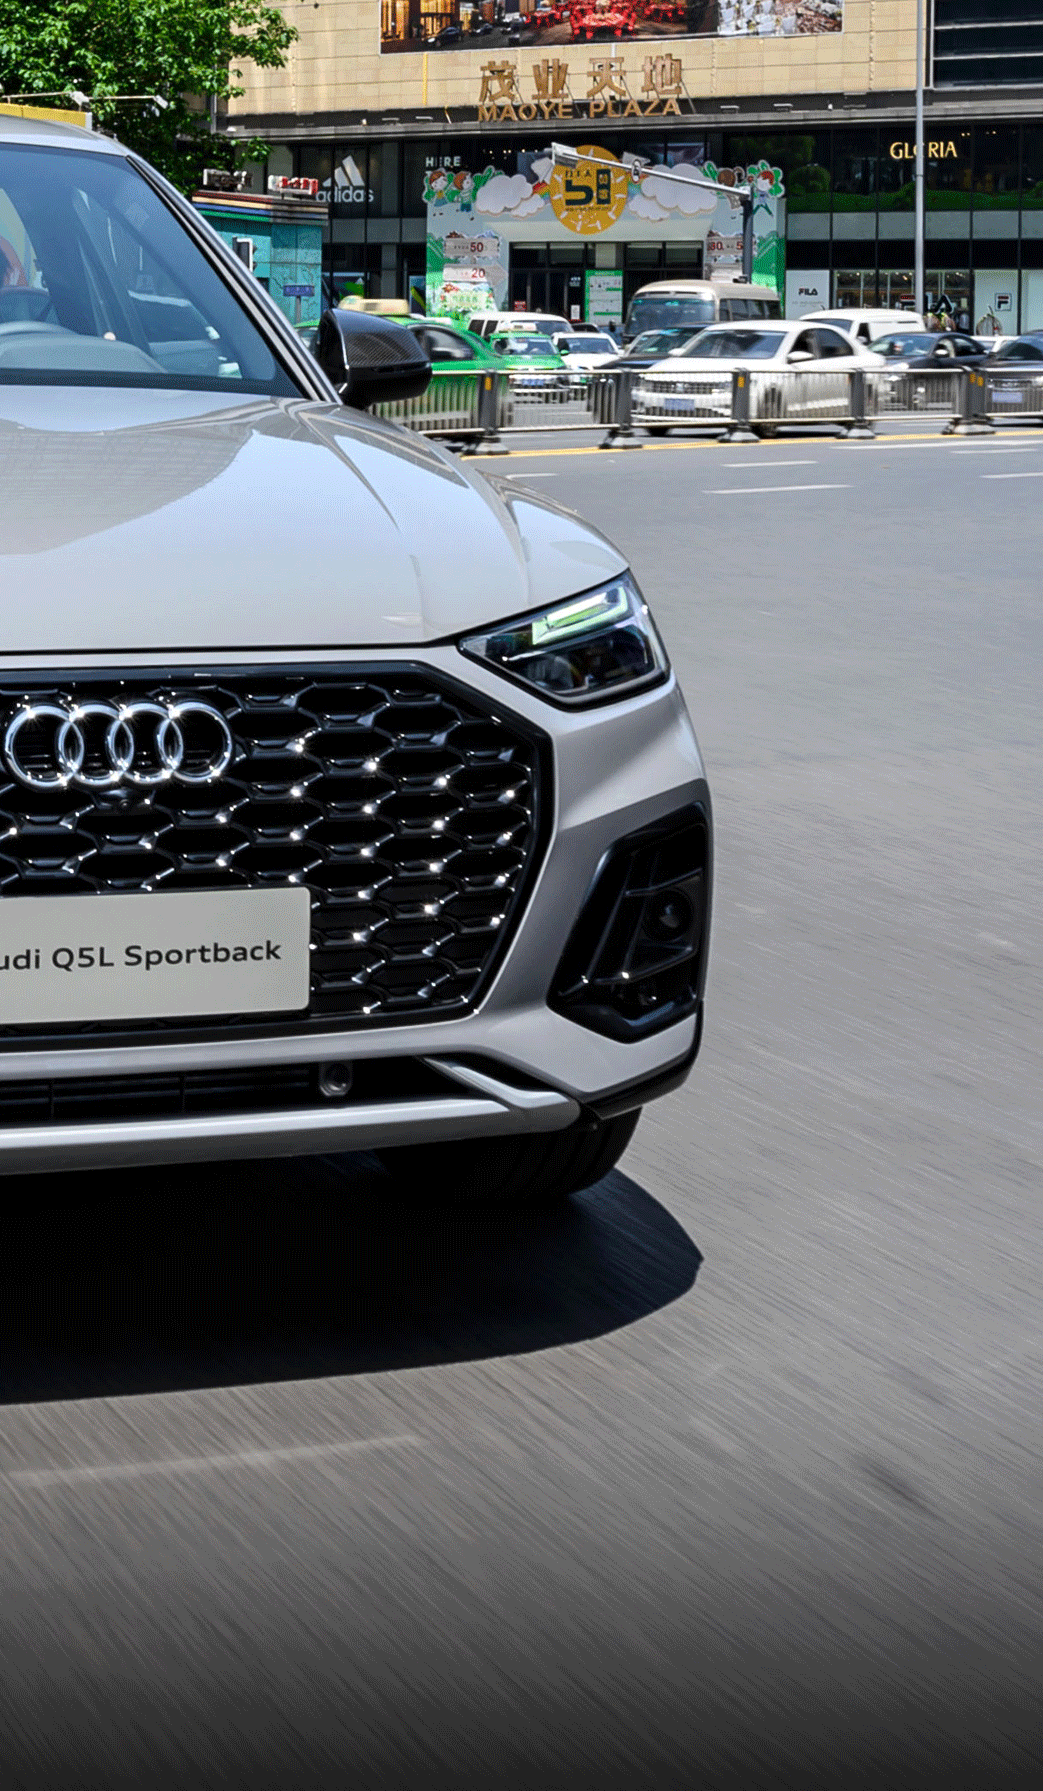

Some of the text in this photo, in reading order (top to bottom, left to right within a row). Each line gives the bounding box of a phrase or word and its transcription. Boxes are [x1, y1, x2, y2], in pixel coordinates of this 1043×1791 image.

[479, 53, 682, 102] 茂业天地
[478, 98, 681, 122] MAOYE PLAZA
[316, 186, 374, 203] adidas
[52, 947, 114, 971] Q5L
[124, 940, 281, 971] Sportback
